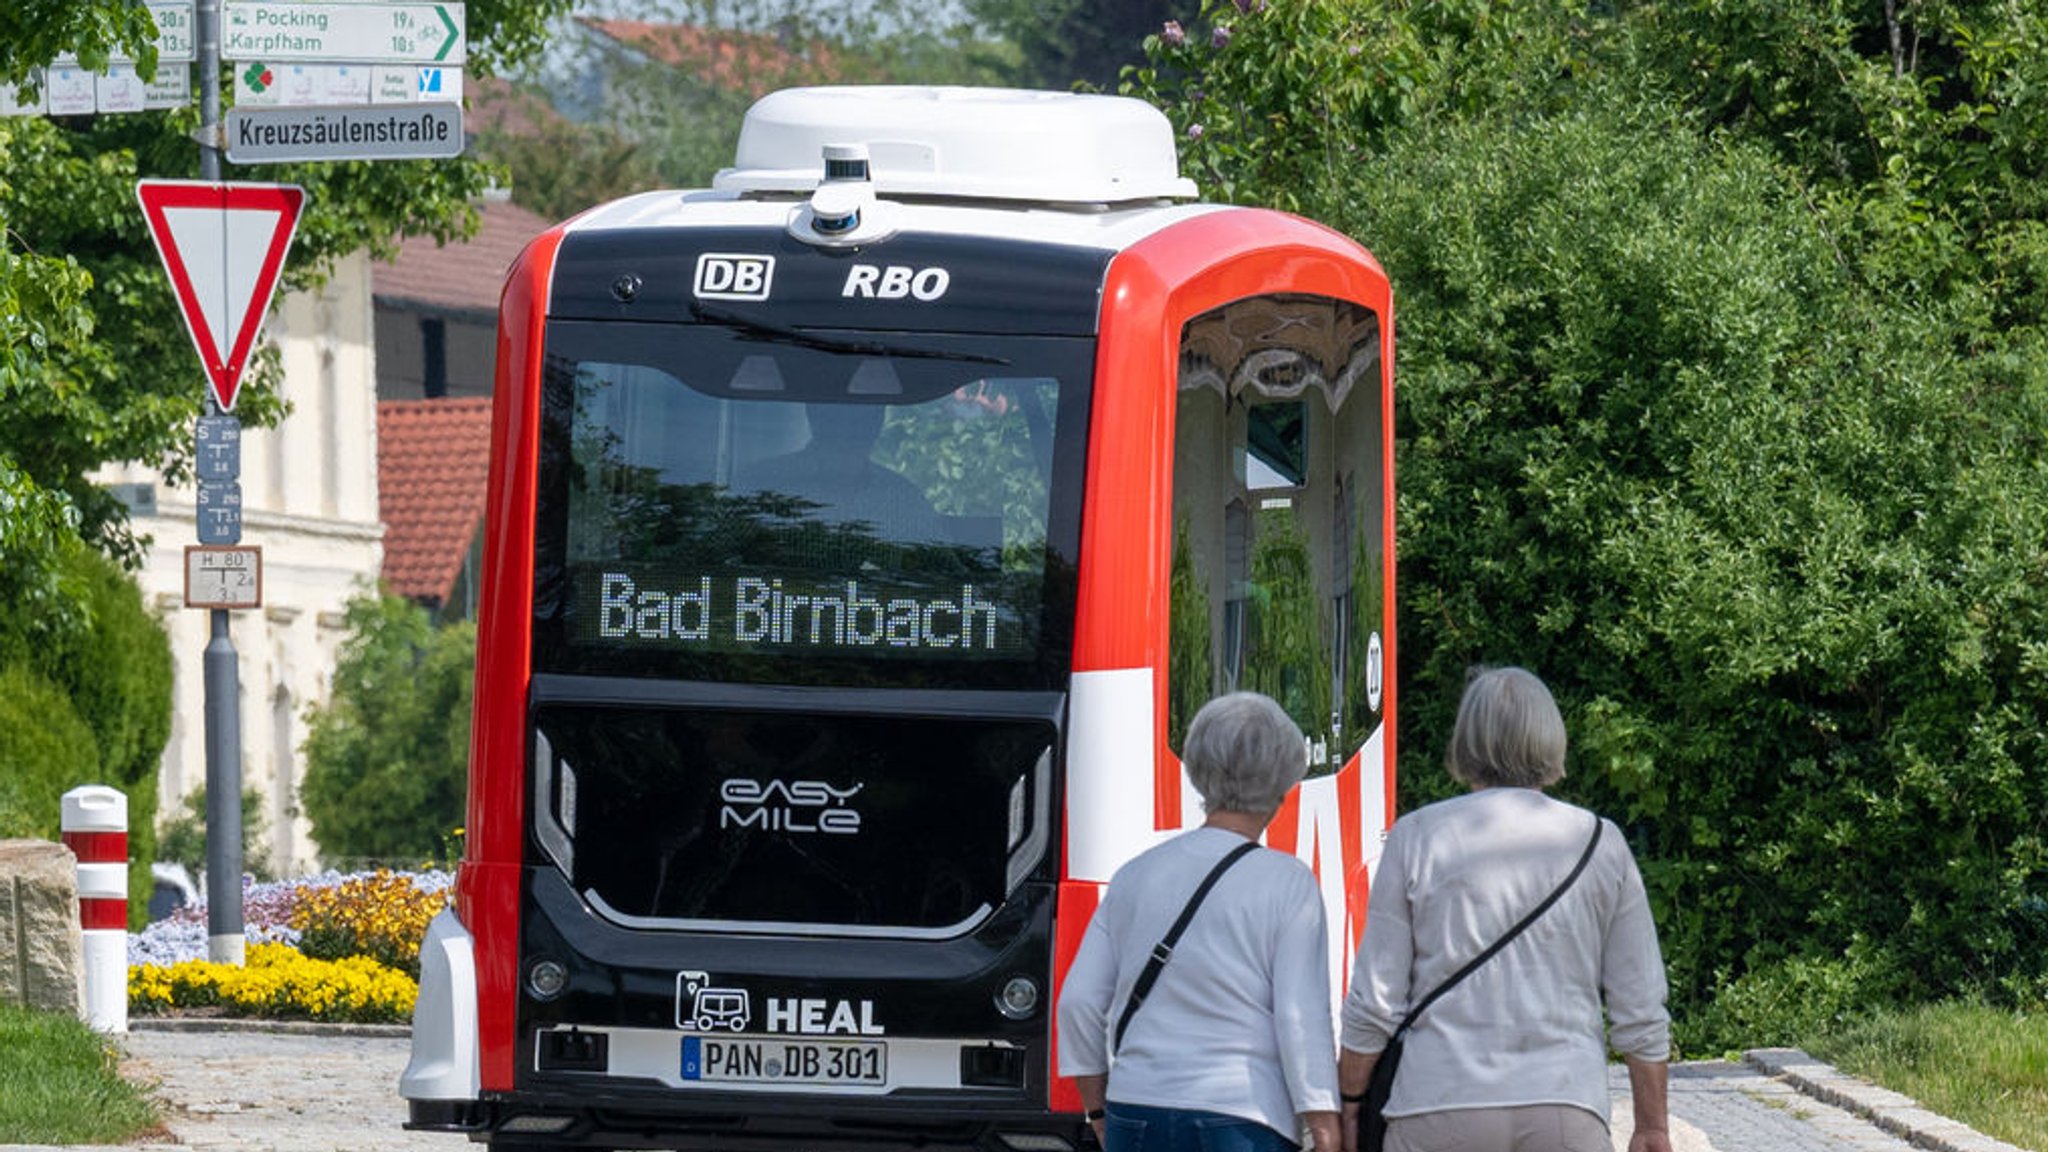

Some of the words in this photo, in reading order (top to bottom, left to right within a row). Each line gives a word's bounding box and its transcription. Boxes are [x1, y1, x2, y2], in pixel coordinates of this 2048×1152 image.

[256, 9, 328, 31] Pocking
[230, 33, 322, 52] Karpfham
[239, 113, 448, 146] Kreuzsäulenstraße
[703, 259, 764, 292] DB
[841, 264, 950, 301] RBO
[202, 553, 213, 565] H
[224, 553, 243, 566] 80
[600, 573, 710, 640] Bad
[735, 576, 997, 649] Birnbach
[766, 998, 885, 1034] HEAL
[705, 1043, 762, 1077] PAN
[784, 1045, 820, 1077] DB
[827, 1046, 880, 1079] 301
